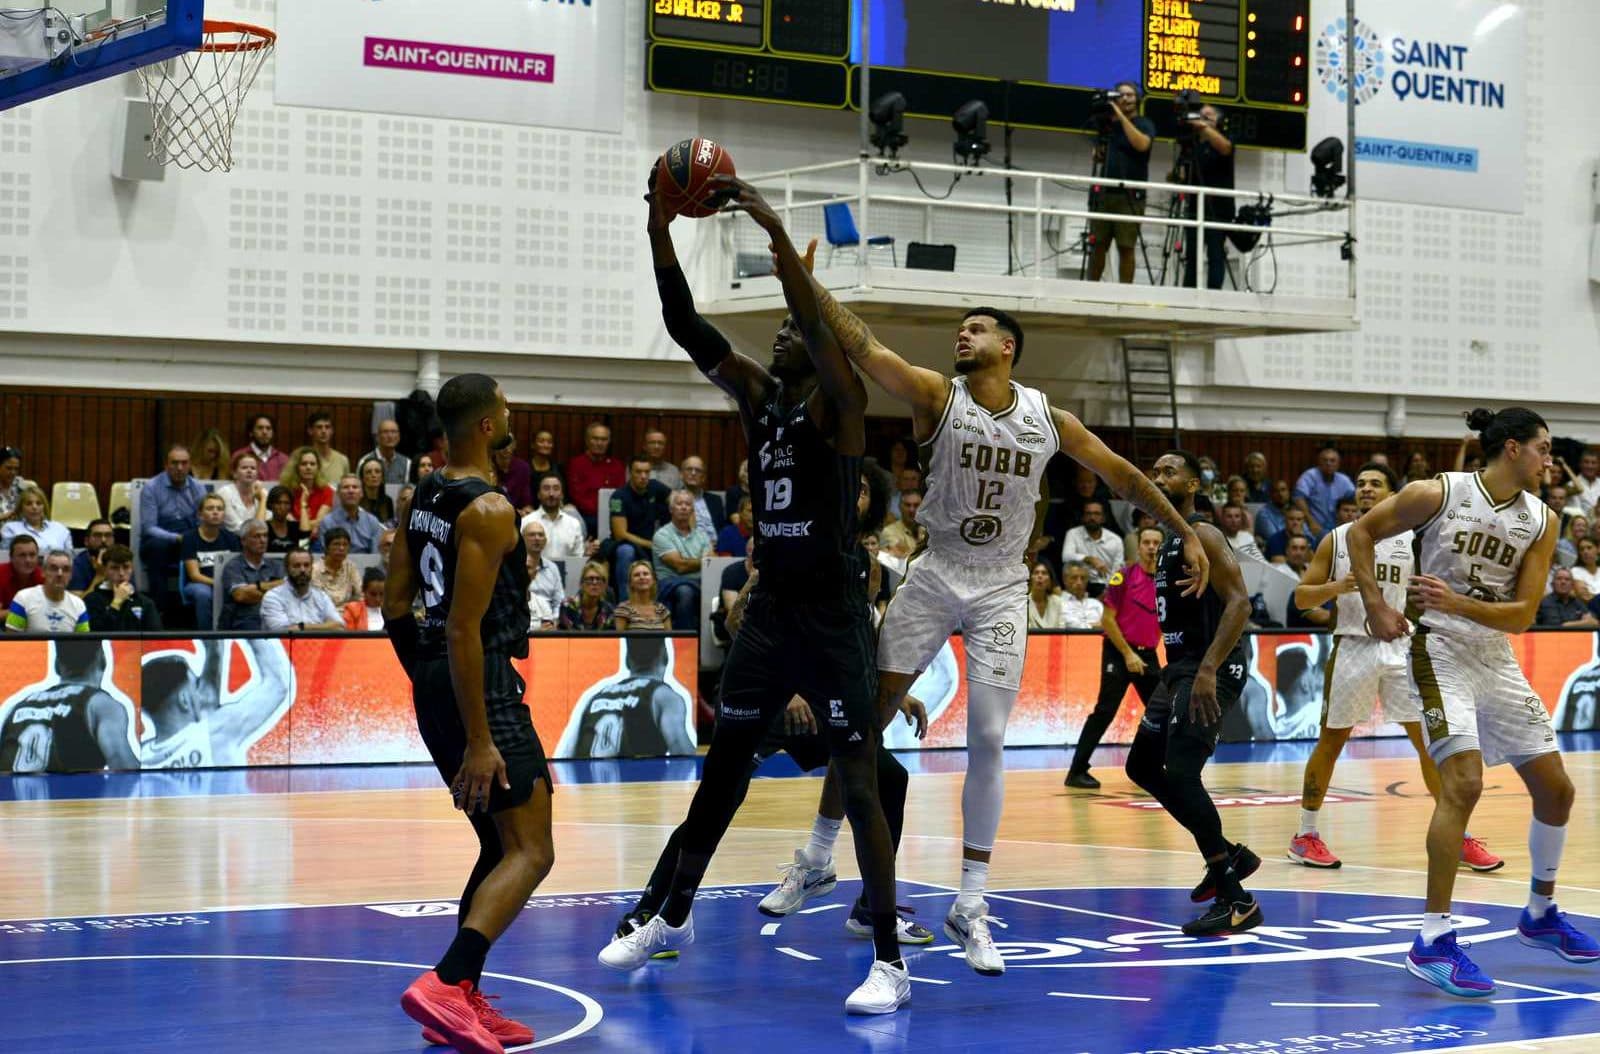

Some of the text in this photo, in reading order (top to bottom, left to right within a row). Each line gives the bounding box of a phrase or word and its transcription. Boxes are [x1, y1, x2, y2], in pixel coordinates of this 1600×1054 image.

[673, 0, 720, 20] WALKER
[726, 4, 743, 22] JR
[373, 43, 546, 76] SAINT-QUENTIN.FR
[1149, 52, 1163, 70] 31
[1391, 37, 1468, 71] SAINT
[1148, 71, 1163, 88] 33
[1391, 70, 1504, 109] QUENTIN
[1354, 141, 1473, 167] SAINT-QUENTIN.FR
[960, 442, 1032, 478] SQBB
[764, 477, 793, 511] 19
[975, 479, 1004, 510] 12
[1451, 531, 1517, 567] SQBB
[420, 541, 446, 608] 9
[1376, 563, 1401, 584] BB
[1154, 596, 1167, 622] 3
[1280, 1034, 1342, 1044] DE
[1340, 1023, 1461, 1039] HAUTS
[1366, 1030, 1489, 1045] CAISSE
